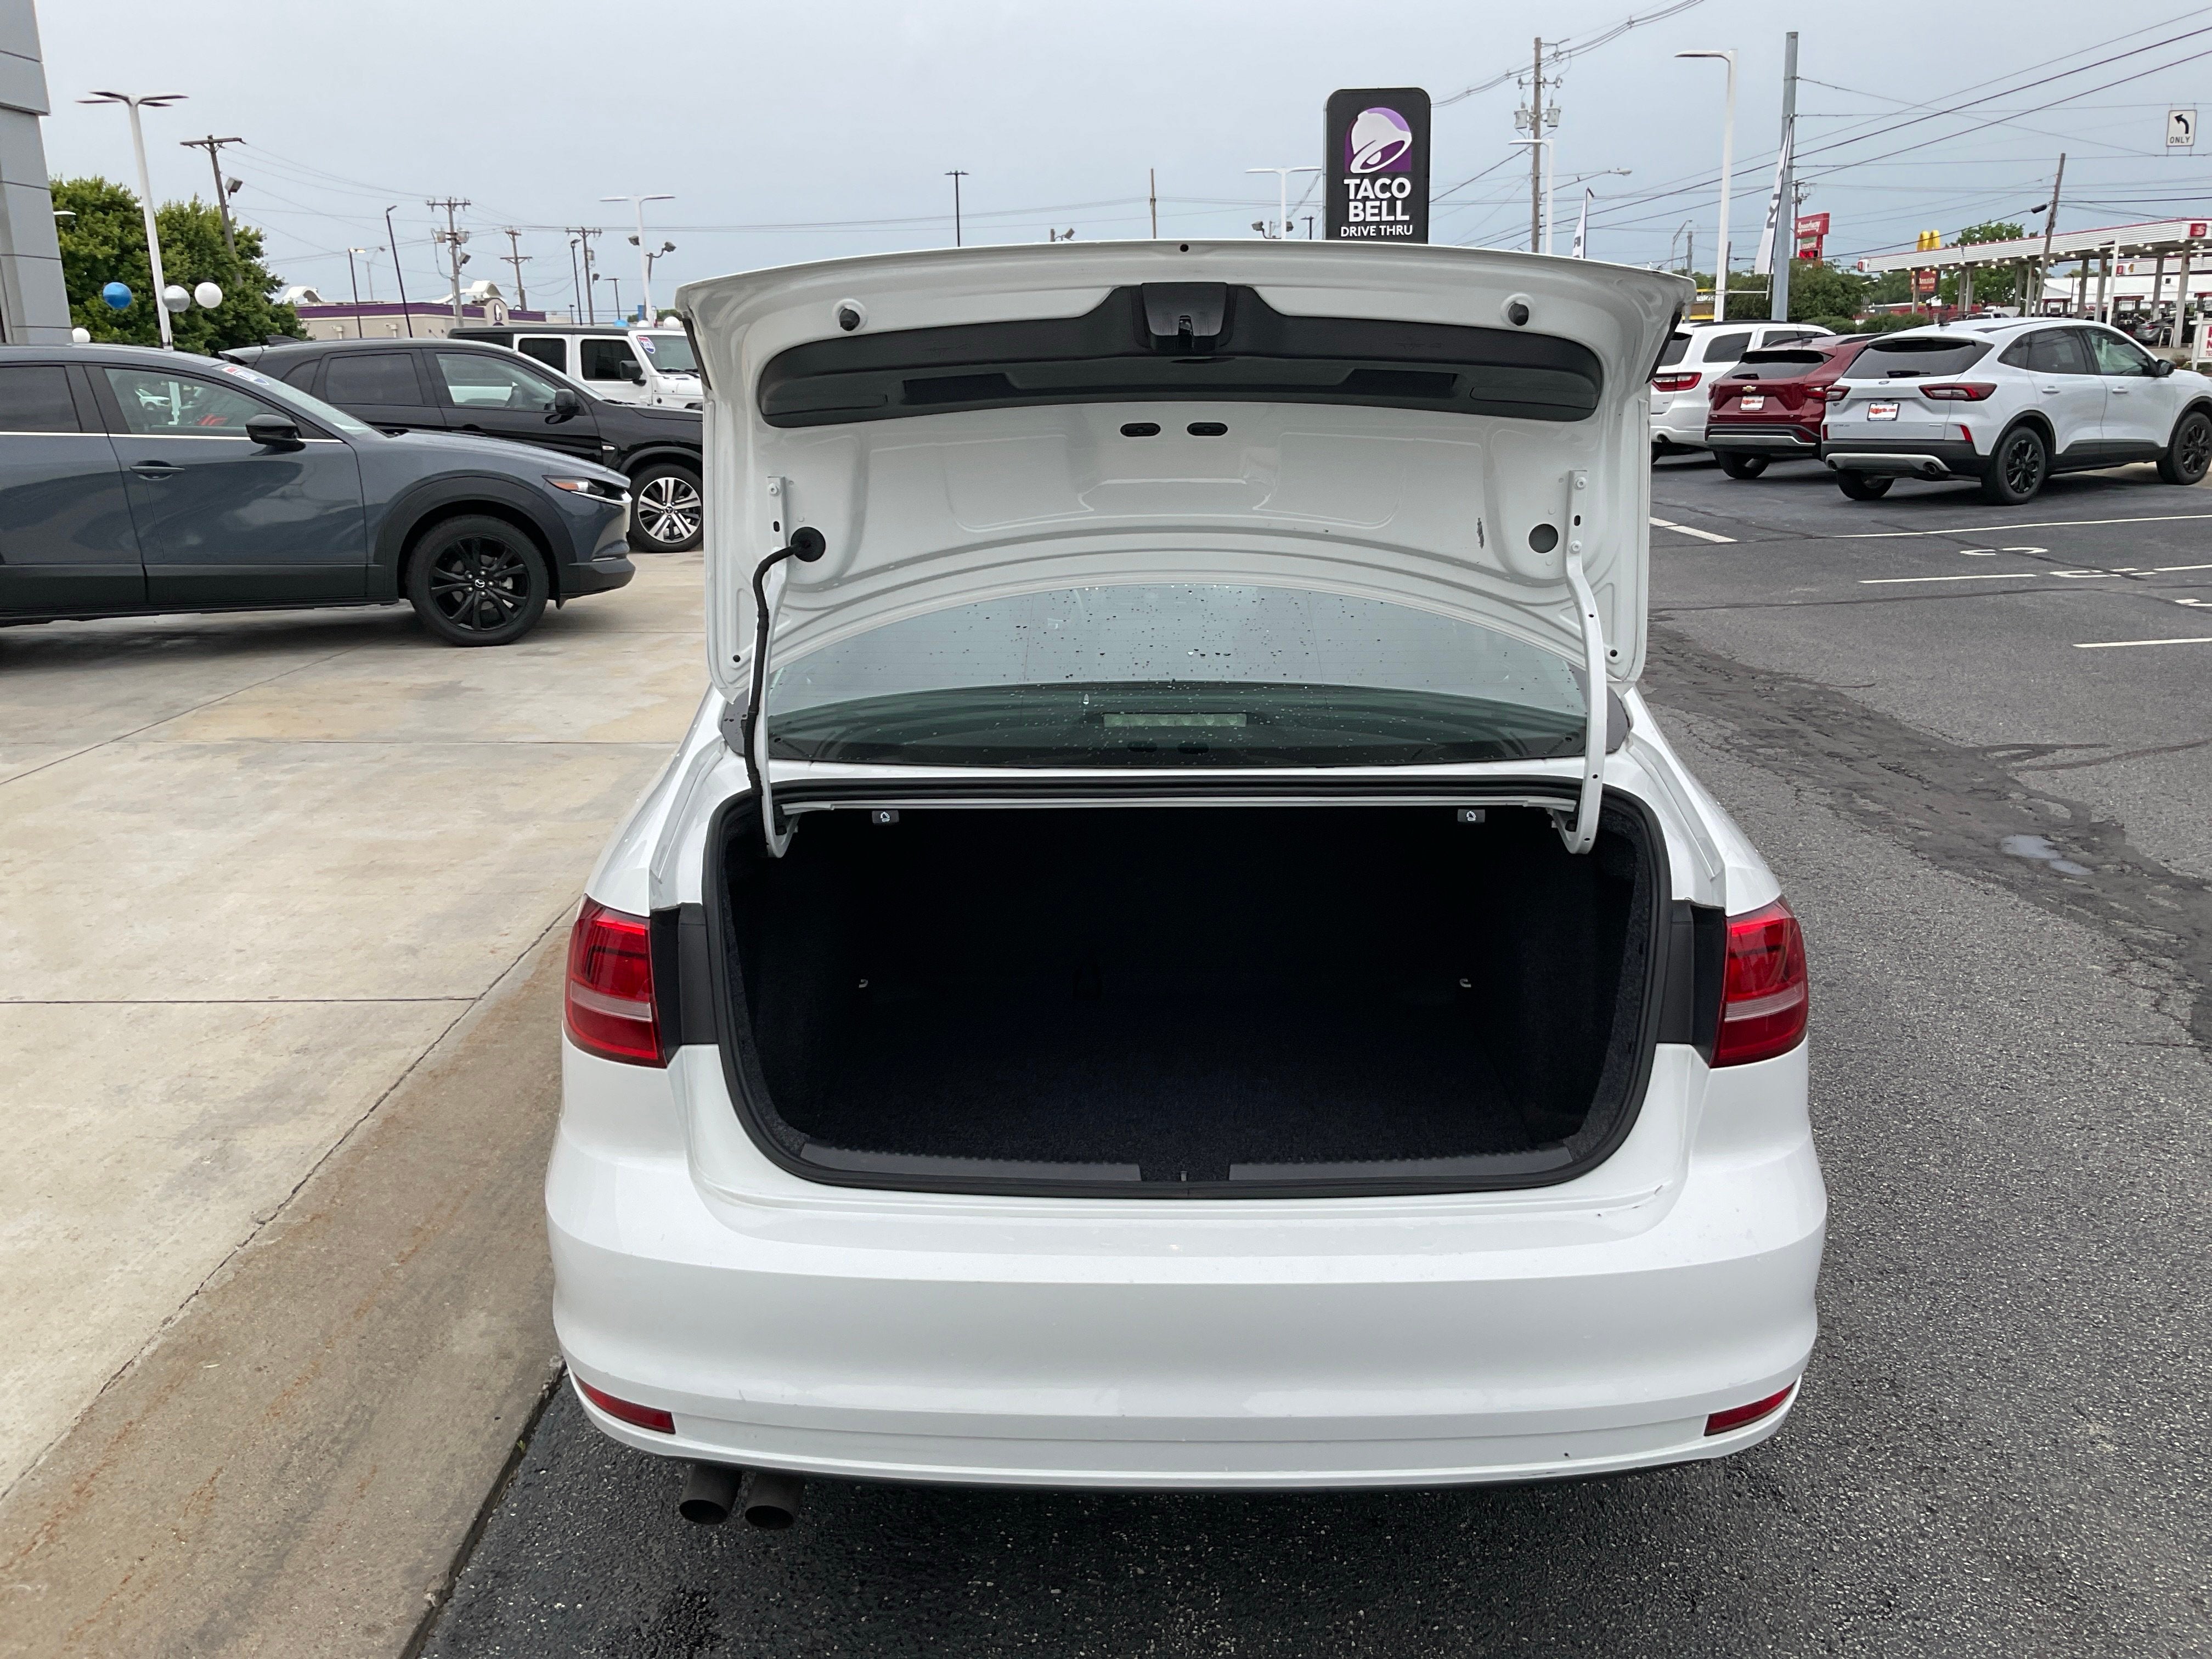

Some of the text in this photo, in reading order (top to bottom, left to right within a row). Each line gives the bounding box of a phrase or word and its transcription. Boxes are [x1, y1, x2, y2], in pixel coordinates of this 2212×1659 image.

[1343, 177, 1412, 200] TACO
[1348, 200, 1409, 222] BELL
[1341, 224, 1413, 237] DRIVE THRU
